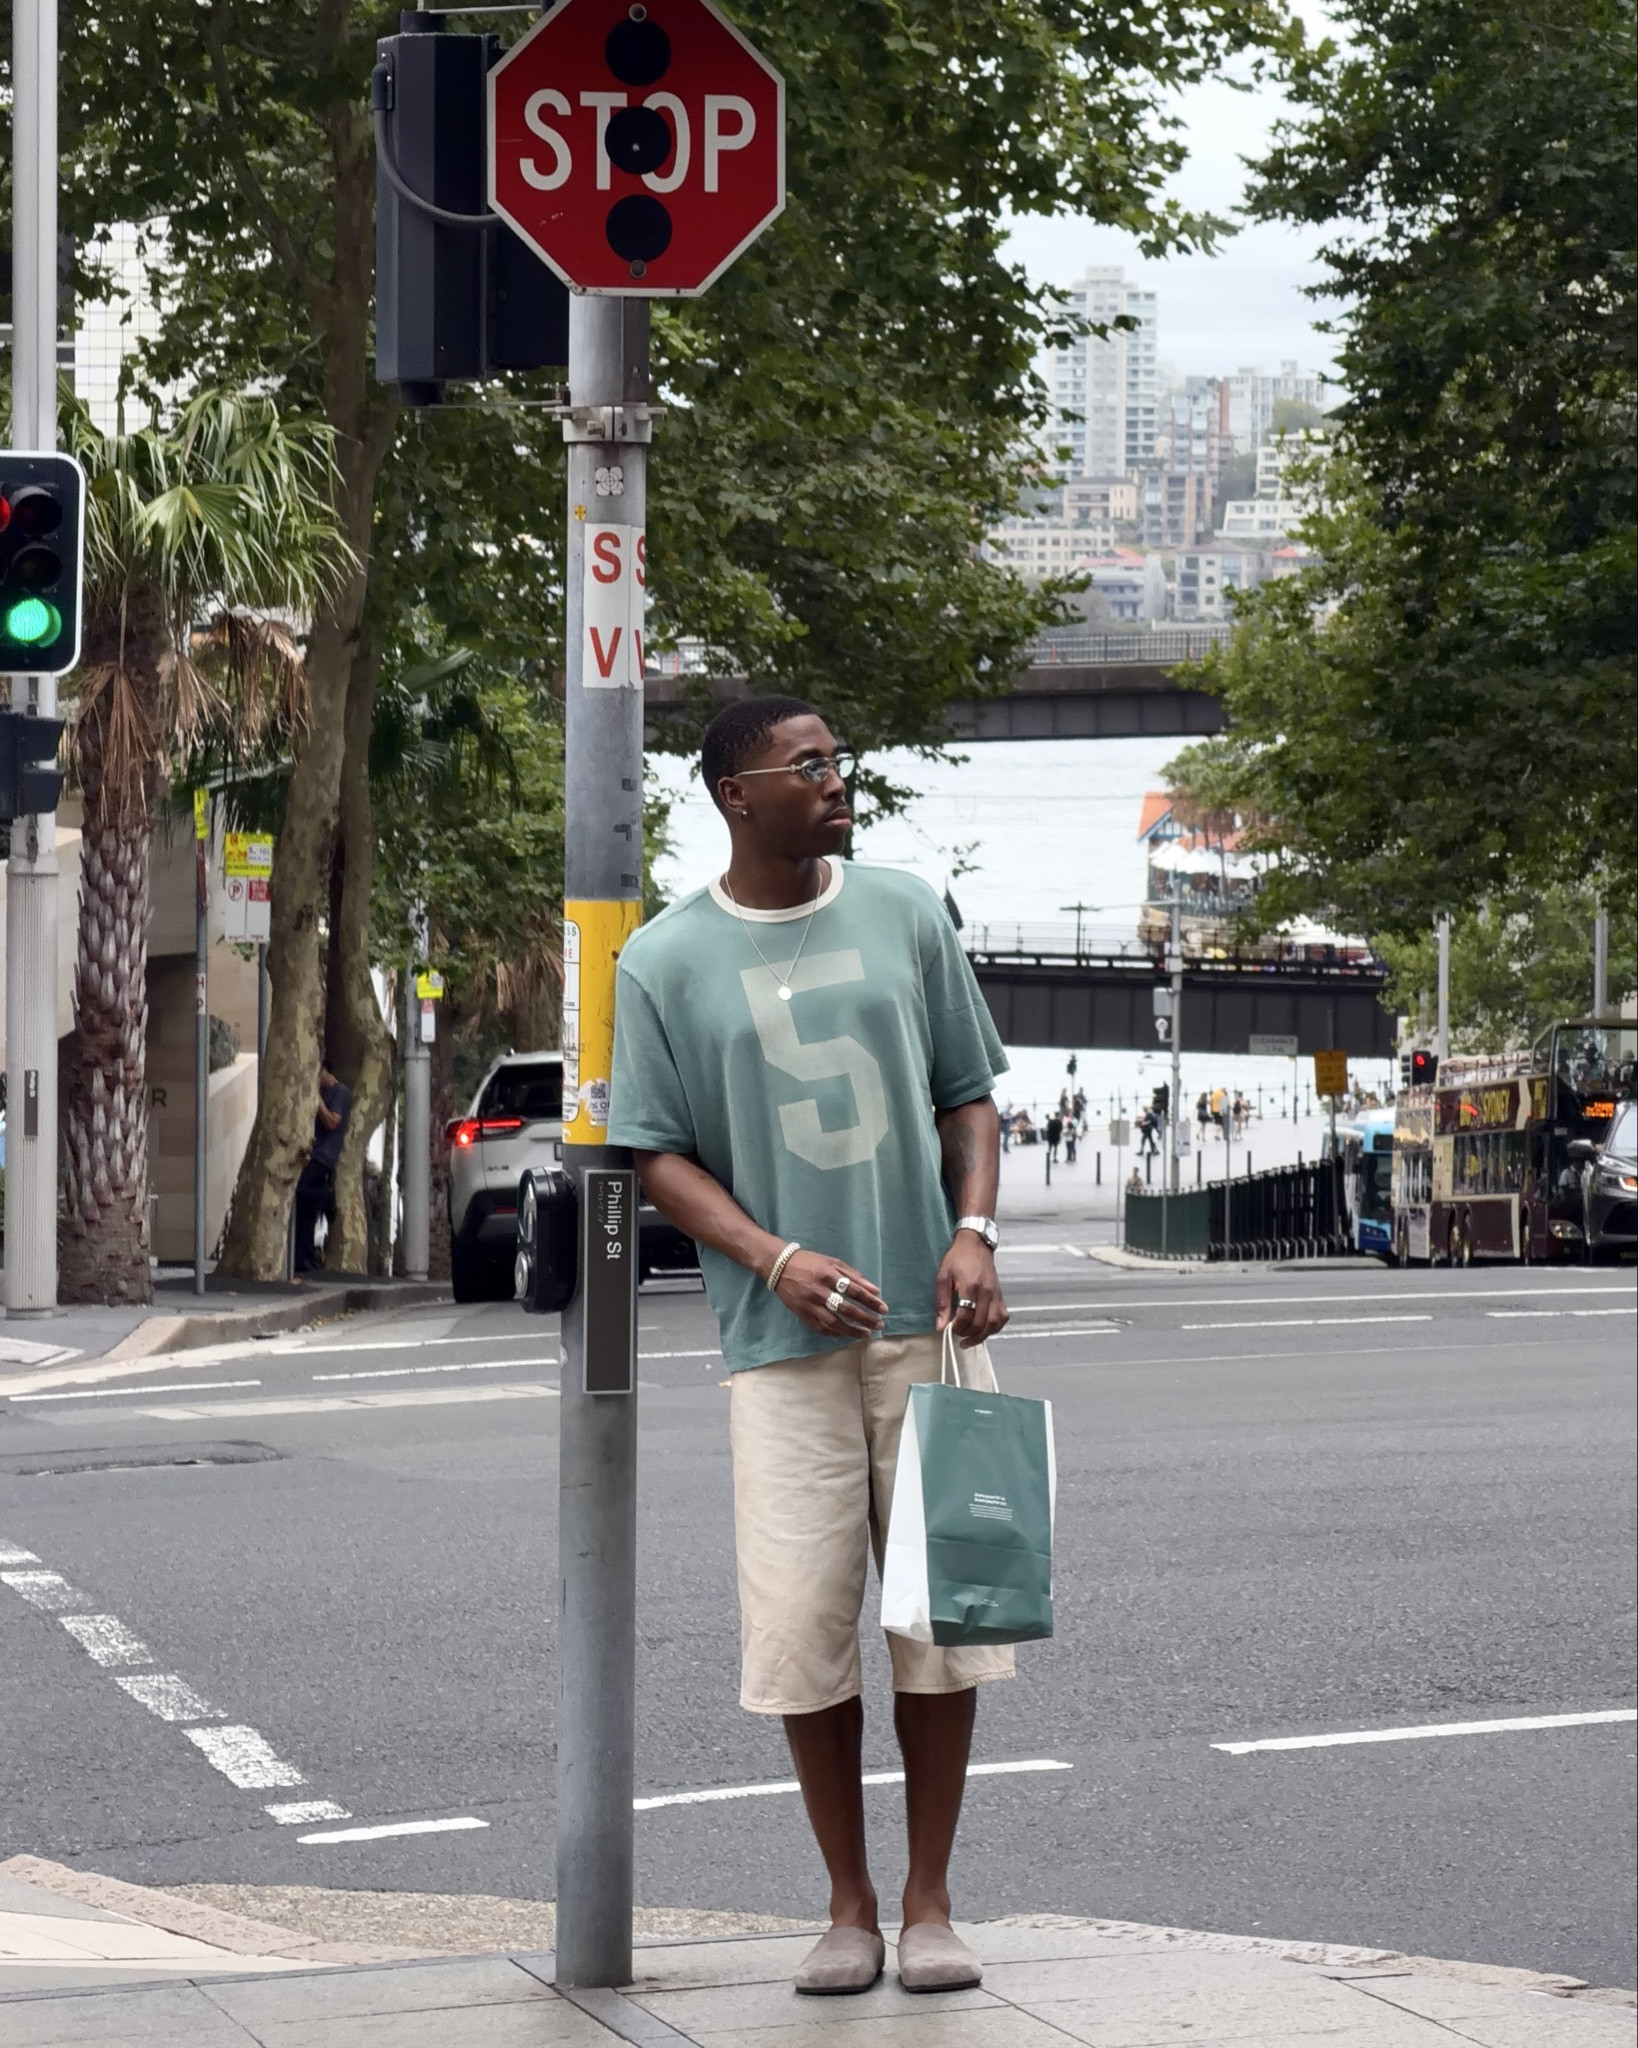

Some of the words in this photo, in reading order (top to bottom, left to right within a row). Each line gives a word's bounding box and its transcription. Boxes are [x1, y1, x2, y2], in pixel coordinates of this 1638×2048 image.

[519, 88, 756, 193] STOP
[592, 532, 621, 584] S
[589, 627, 622, 678] V
[739, 948, 889, 1171] 5
[604, 1181, 622, 1235] Phillip
[606, 1241, 622, 1260] St
